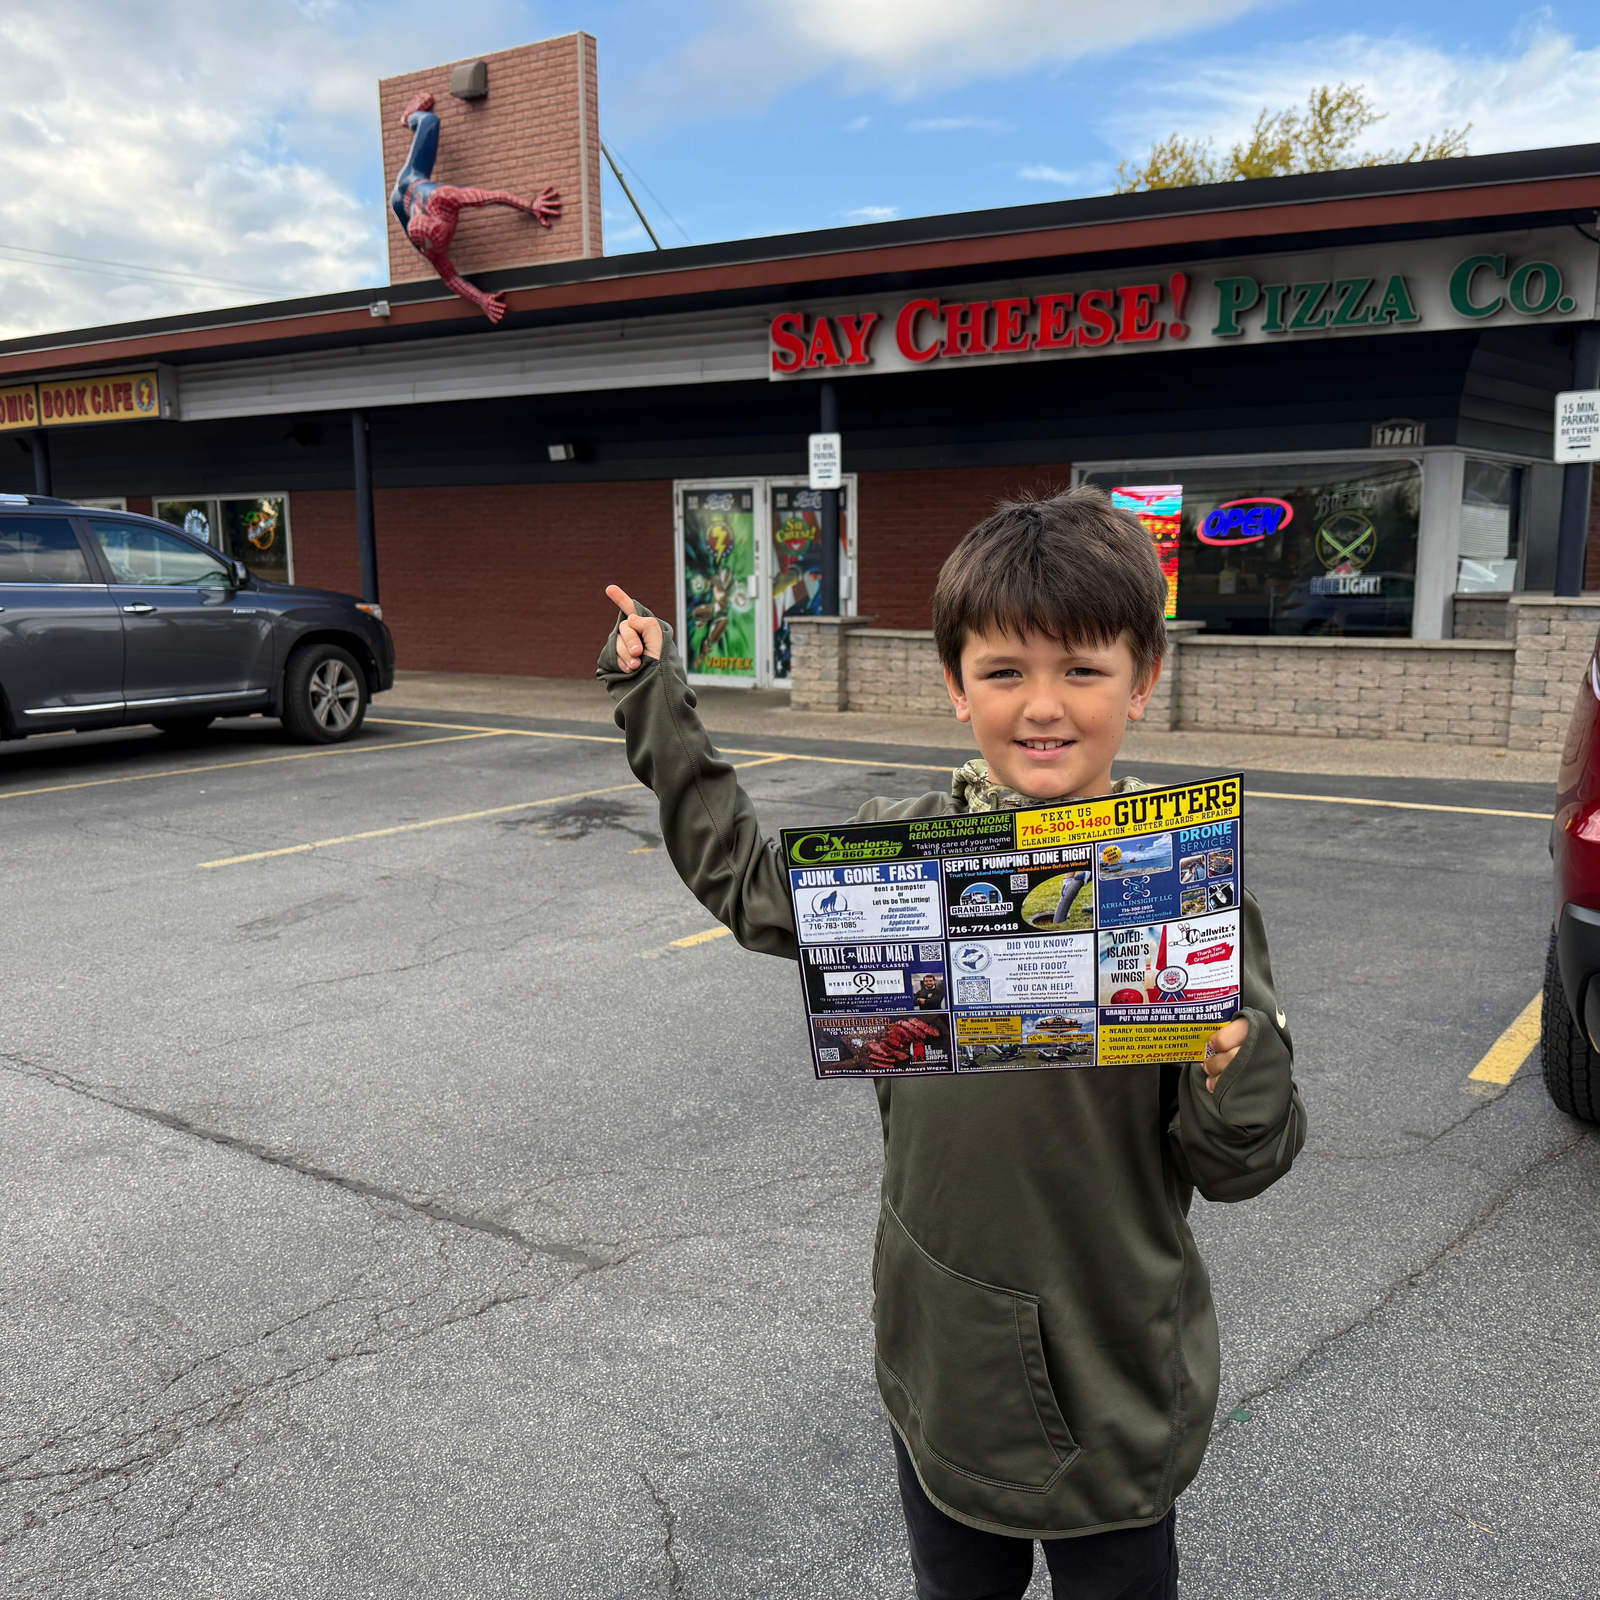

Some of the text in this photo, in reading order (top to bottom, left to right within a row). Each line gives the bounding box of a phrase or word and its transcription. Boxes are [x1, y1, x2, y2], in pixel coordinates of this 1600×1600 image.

[770, 252, 1577, 374] SAY CHEESE! PIZZA CO.
[42, 387, 88, 418] BOOK
[90, 382, 134, 414] CAFE
[1564, 402, 1598, 414] 15 MIN.
[1561, 414, 1599, 426] PARKING
[1561, 426, 1600, 436] BETWEEN
[1568, 436, 1592, 444] SIGNS
[1203, 506, 1284, 537] OPEN
[706, 656, 753, 670] VORTEX
[1114, 781, 1237, 826] GUTTERS
[1040, 807, 1092, 822] TEXT US
[909, 814, 1010, 832] FOR ALL YOUR HOME
[1021, 815, 1112, 836] 716-300-1480
[1021, 808, 1233, 846] CLEANING INSTALLATION GUTTER GUARDS REPAIRS
[909, 824, 1012, 840] REMODELING NEEDS!
[1180, 822, 1232, 843] DRONE
[942, 840, 958, 848] care
[970, 838, 988, 847] your
[989, 836, 1010, 844] home
[1180, 835, 1232, 853] SERVICES
[842, 848, 898, 858] 860-4423
[945, 847, 1091, 872] SEPTIC PUMPING DONE RIGHT
[798, 864, 928, 886] JUNK. GONE. FAST.
[910, 896, 930, 904] Lifting!
[1101, 894, 1172, 910] AERIAL INSIGHT LLC
[952, 903, 1012, 914] GRAND ISLAND
[809, 921, 857, 930] 716-783-1085
[949, 922, 1018, 934] 716-774-0418
[1112, 930, 1144, 944] VOTED:
[1200, 932, 1234, 944] ISLAND LANES
[1006, 938, 1074, 950] DID YOU KNOW?
[808, 944, 914, 965] KARATE KRAV MAGA
[1107, 943, 1150, 958] ISLAND'S
[1196, 946, 1222, 956] Thank You
[1118, 958, 1138, 970] BEST
[1194, 954, 1210, 963] Grand
[1018, 961, 1067, 971] NEED FOOD?
[1111, 971, 1145, 984] WINGS!
[1012, 982, 1073, 992] YOU CAN HELP!
[1106, 1000, 1235, 1016] GRAND ISLAND SMALL BUSINESS SPOTLIGHT
[1196, 1012, 1224, 1020] RESULTS.
[816, 1017, 890, 1028] DELIVERED FRESH
[1135, 1026, 1156, 1034] 10,000
[1146, 1050, 1203, 1059] ADVERTISE!
